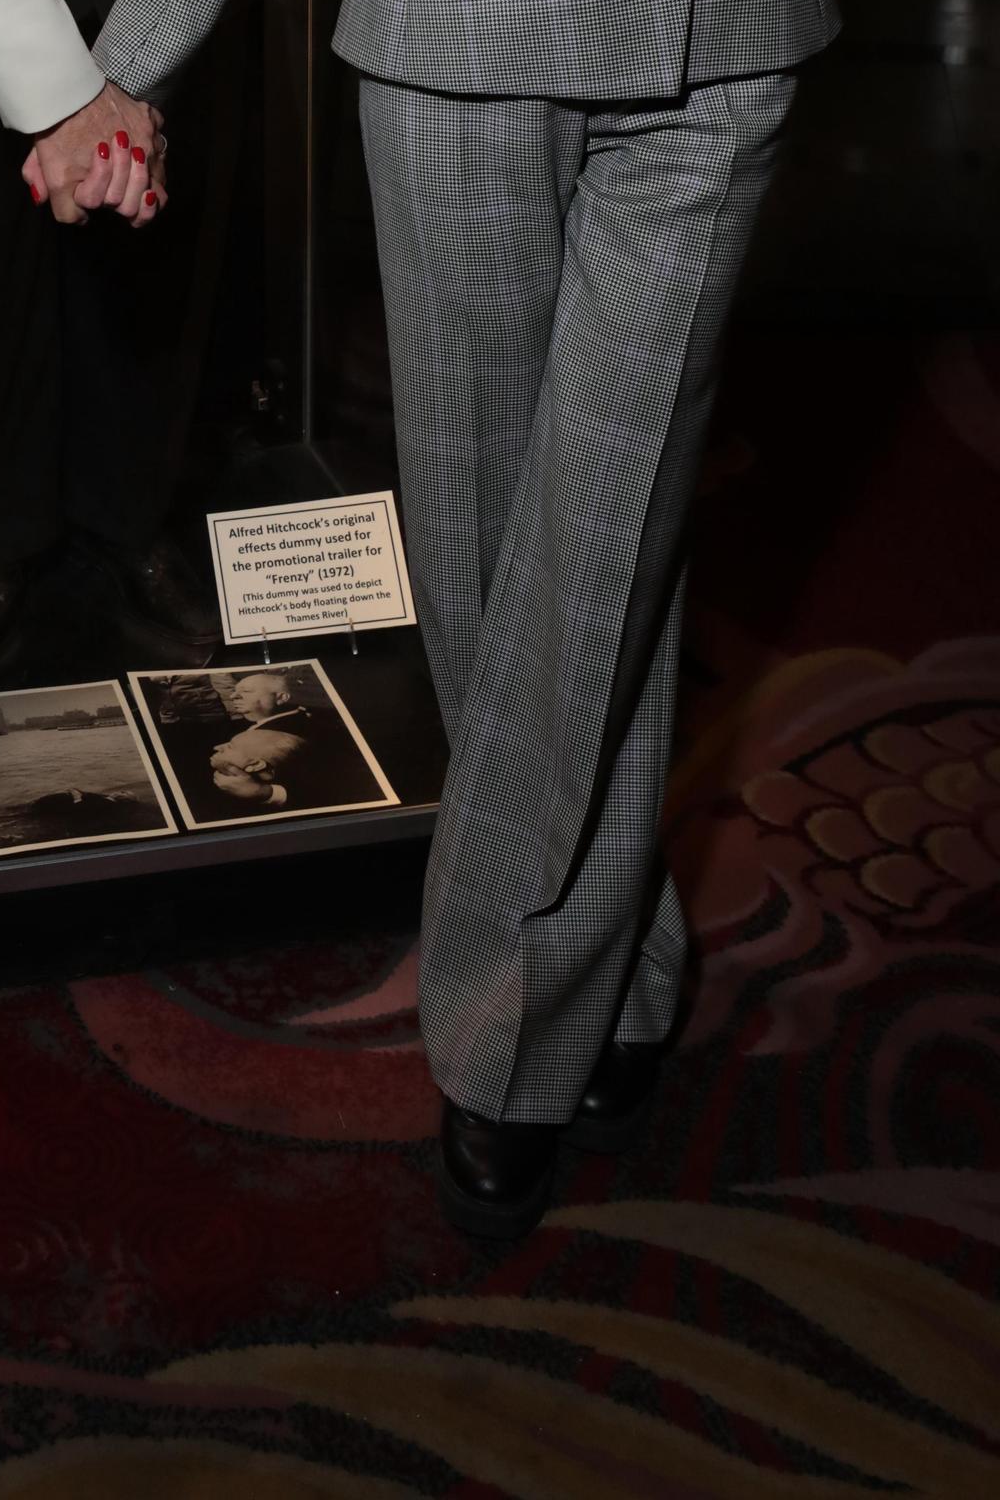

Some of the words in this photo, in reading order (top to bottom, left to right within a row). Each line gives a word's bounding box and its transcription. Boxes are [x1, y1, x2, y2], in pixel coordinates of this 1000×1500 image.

[229, 525, 263, 539] Alfred
[332, 511, 376, 527] original
[238, 539, 276, 555] effects
[279, 537, 322, 553] dummy
[325, 531, 352, 545] used
[354, 530, 372, 541] for
[232, 560, 252, 572] the
[254, 549, 325, 572] promotional
[328, 546, 363, 561] trailer
[365, 545, 383, 557] for
[318, 565, 354, 580] (1972)
[242, 591, 264, 603] (This
[266, 587, 299, 601] dummy
[301, 585, 318, 595] was
[320, 582, 341, 594] used
[343, 581, 353, 590] to
[355, 578, 383, 592] depict
[290, 599, 312, 612] body
[313, 595, 348, 610] floating
[350, 592, 374, 604] down
[376, 590, 391, 600] the
[286, 612, 320, 624] Thames
[322, 608, 348, 620] River)
